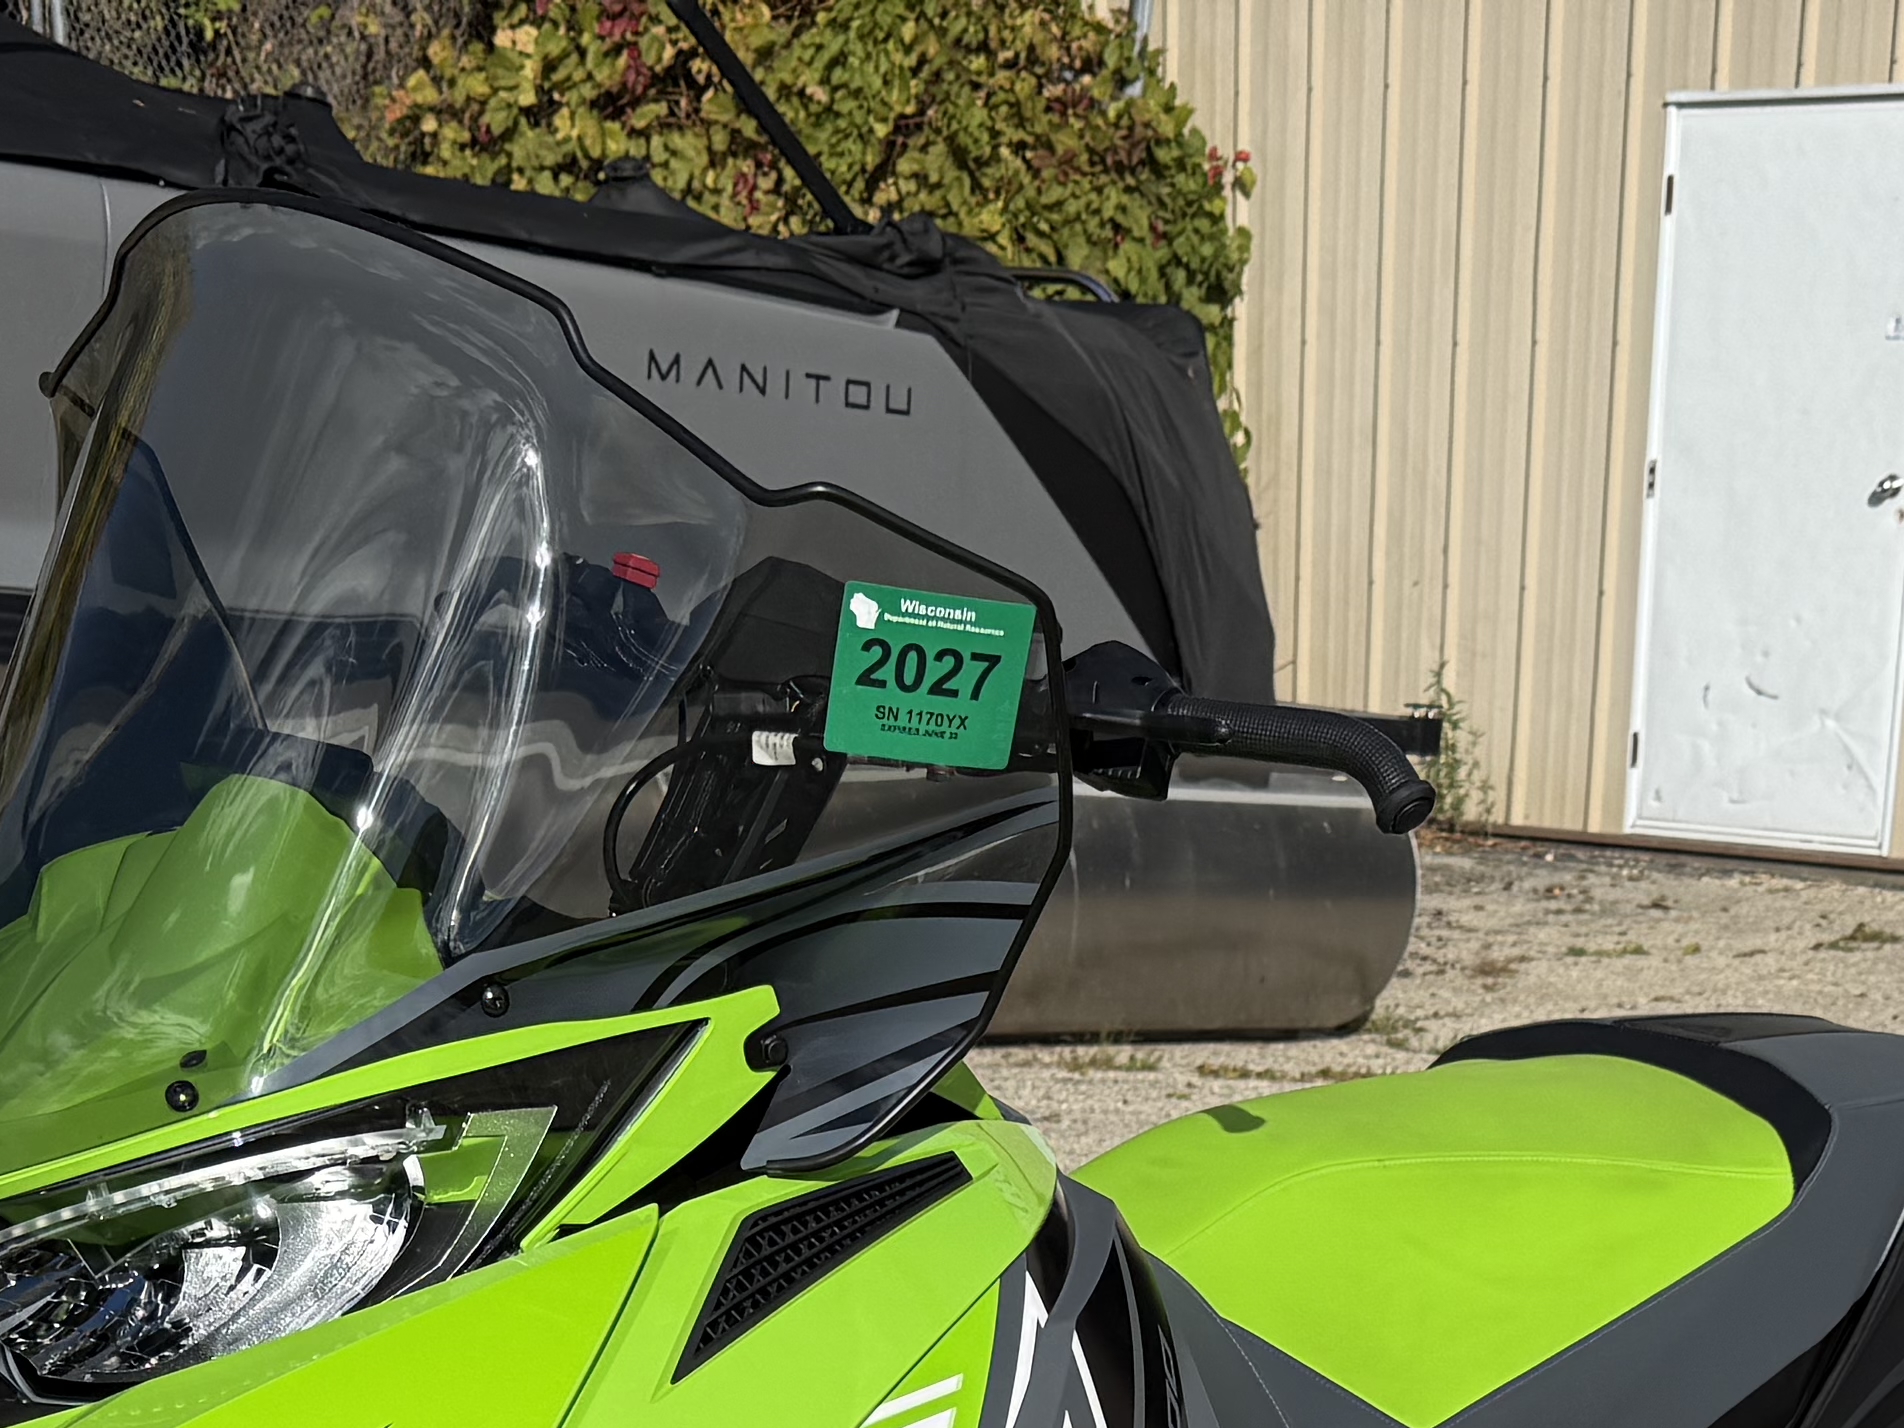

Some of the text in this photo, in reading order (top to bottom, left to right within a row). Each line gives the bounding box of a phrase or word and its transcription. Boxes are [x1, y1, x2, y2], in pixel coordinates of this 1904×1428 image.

[647, 347, 913, 417] MANITOU
[900, 597, 977, 623] Wisconsin
[854, 637, 1003, 702] 2027
[874, 704, 970, 731] SN 1170YX
